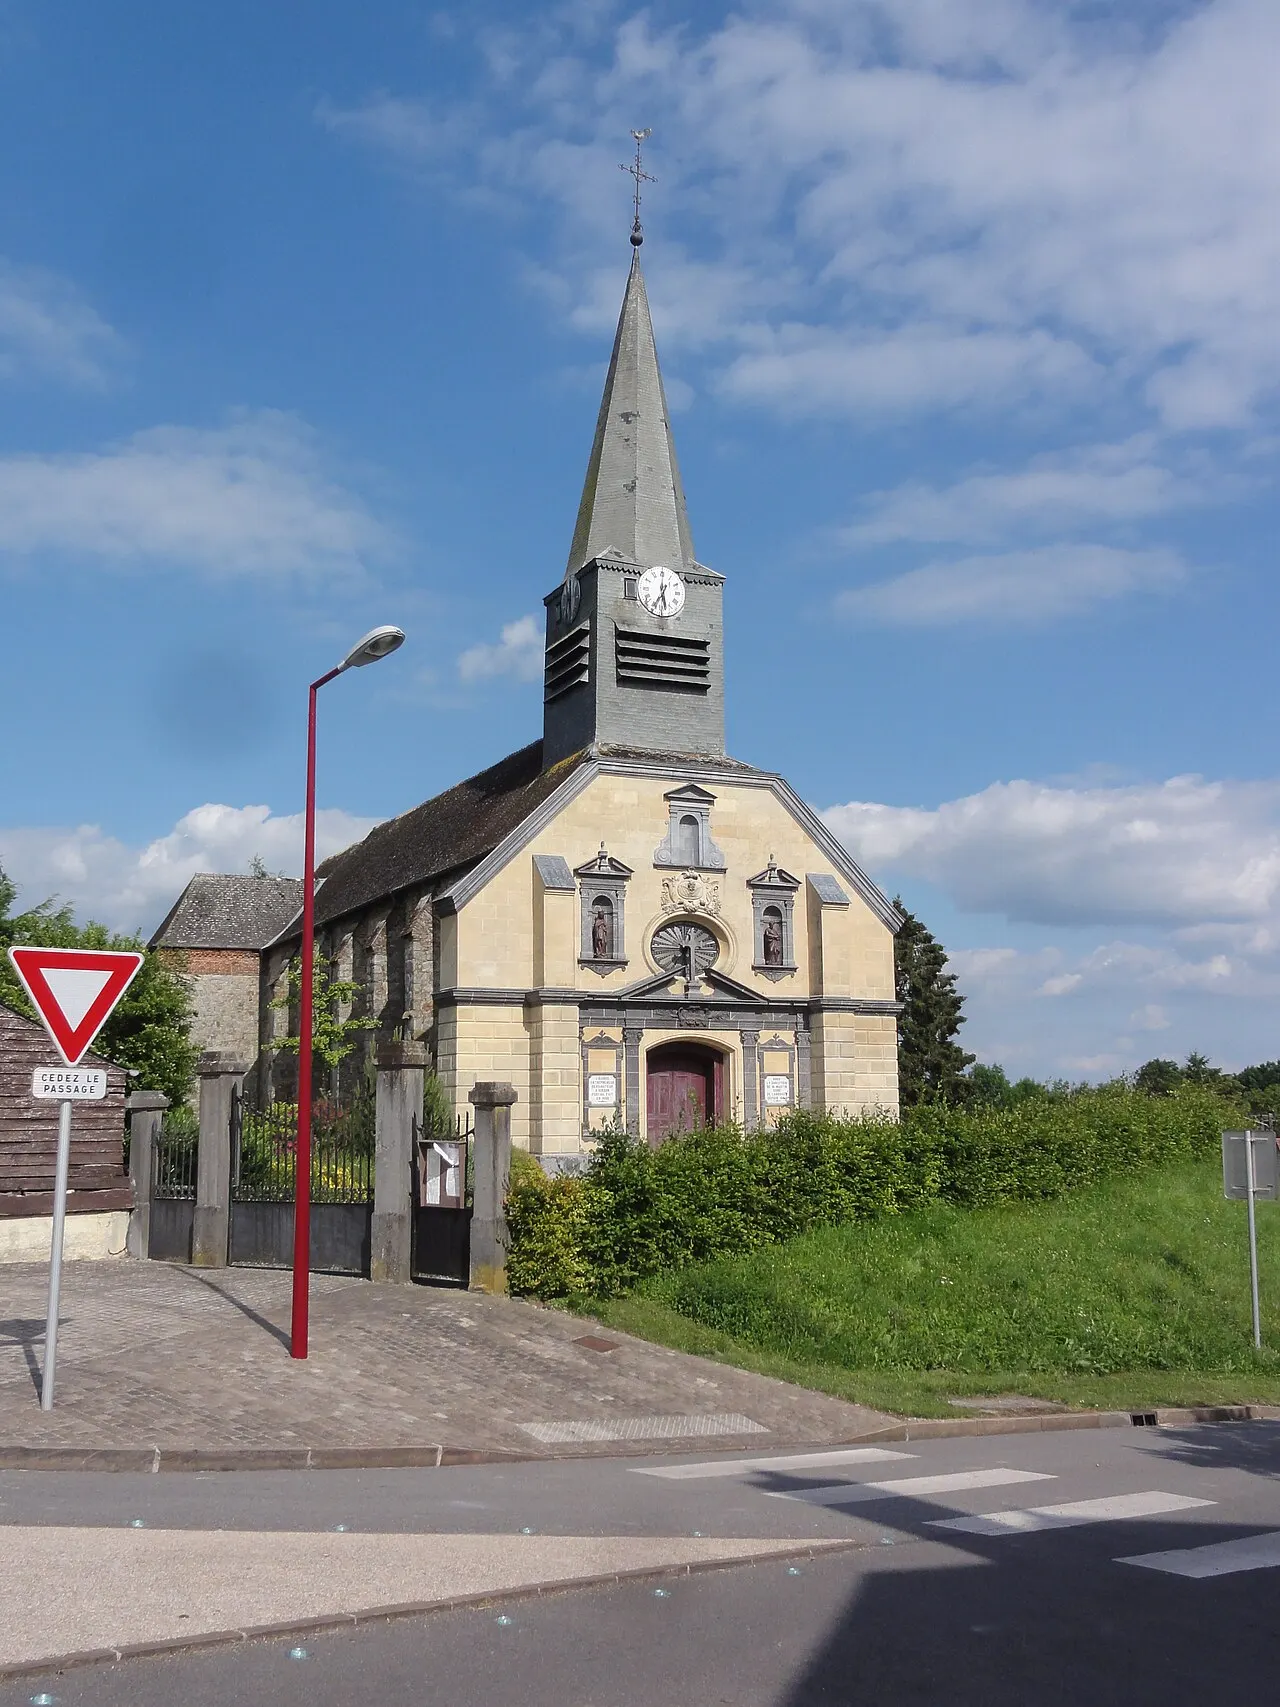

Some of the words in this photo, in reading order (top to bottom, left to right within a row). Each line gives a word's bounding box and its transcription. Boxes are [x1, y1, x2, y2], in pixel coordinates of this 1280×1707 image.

[41, 1073, 79, 1083] CEDEZ
[87, 1074, 99, 1083] LE
[44, 1085, 95, 1094] PASSAGE
